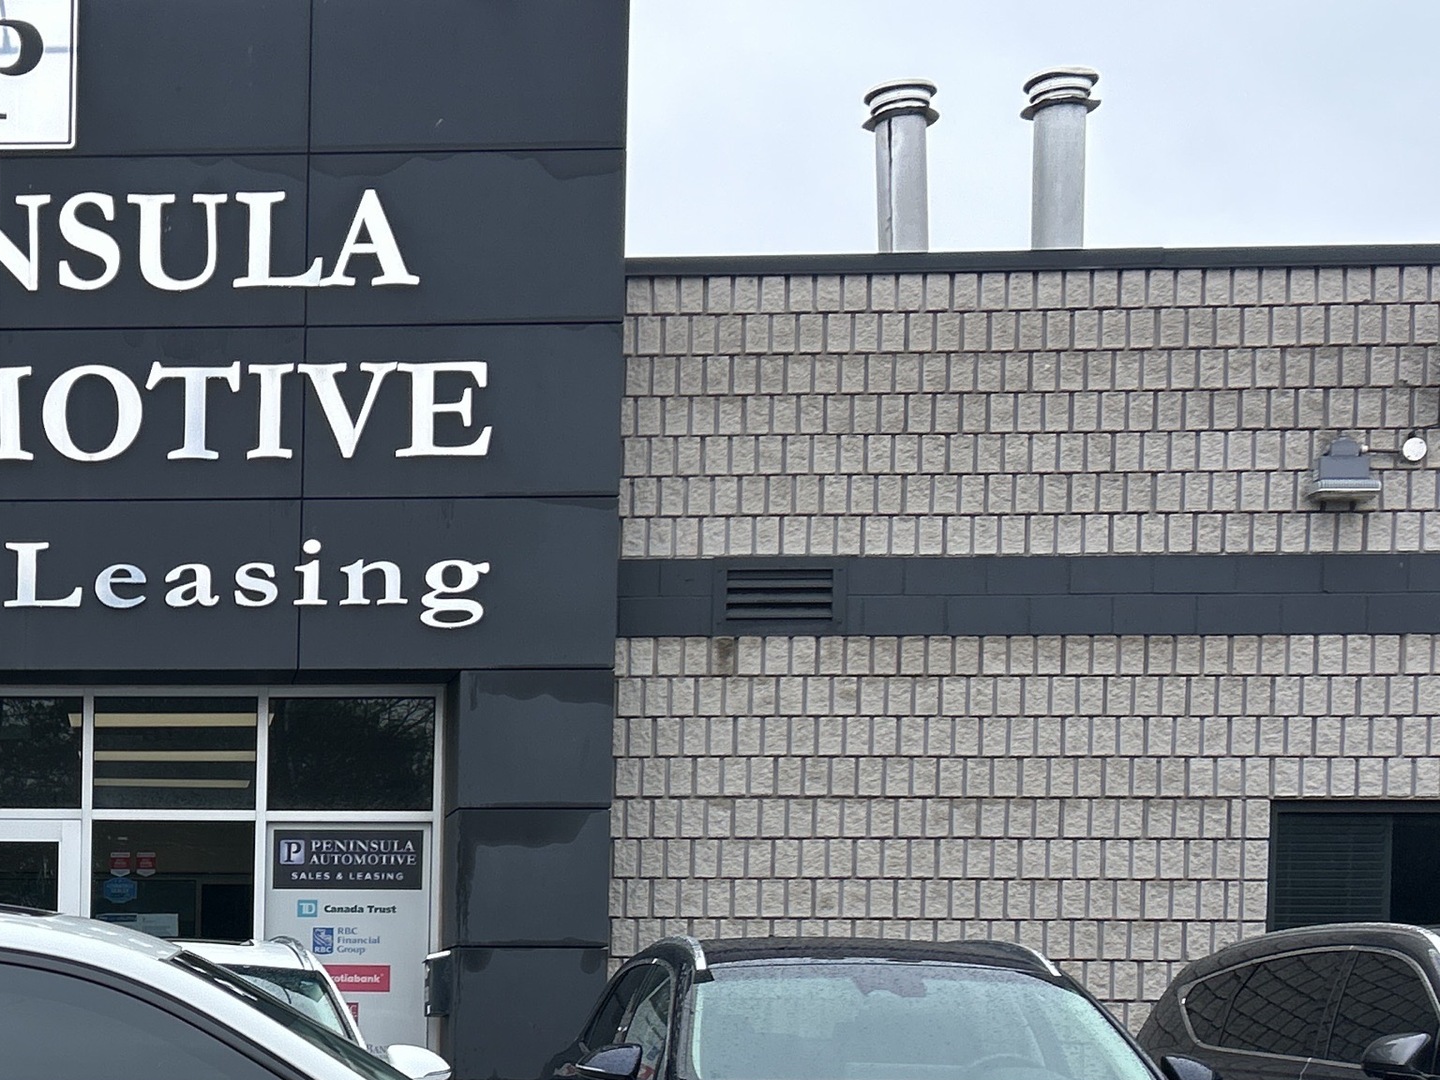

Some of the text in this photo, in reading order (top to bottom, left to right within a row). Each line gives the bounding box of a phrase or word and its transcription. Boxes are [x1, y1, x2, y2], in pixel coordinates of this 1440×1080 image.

[3, 538, 490, 629] Leasing
[310, 839, 415, 853] PENINSULA
[284, 841, 302, 863] P
[309, 854, 417, 866] AUTOMOTIVE
[291, 871, 404, 881] SALES & LEASING
[299, 902, 397, 914] TD Canada Trust
[337, 927, 357, 935] RBC
[337, 936, 380, 944] Financial
[314, 945, 332, 953] RBC
[337, 946, 366, 955] Group
[330, 973, 381, 984] otiabank
